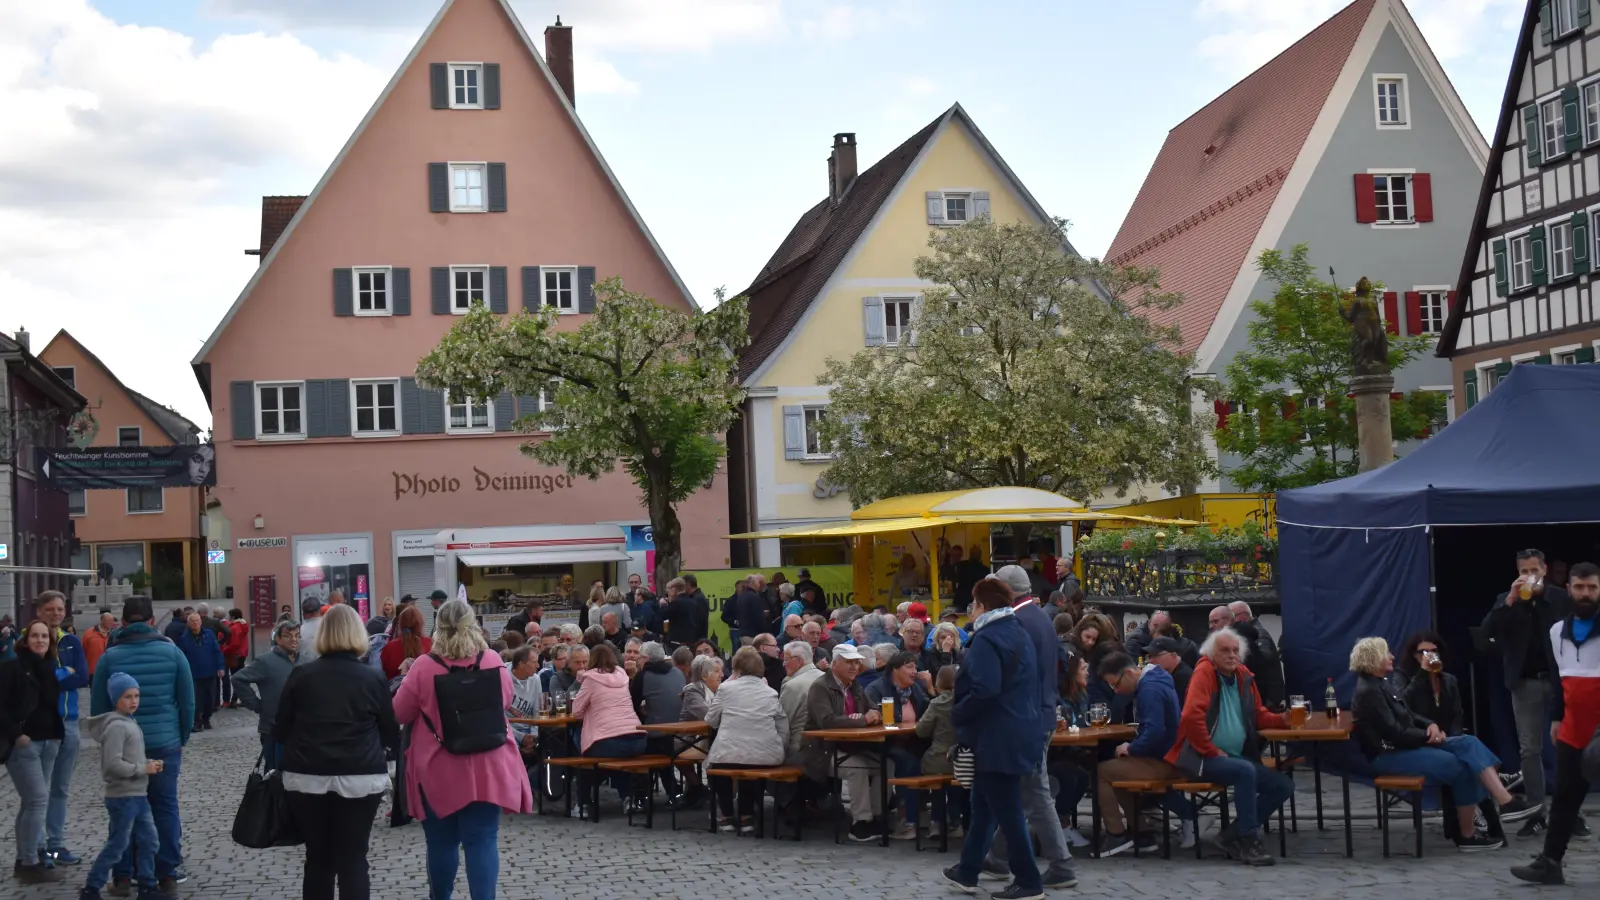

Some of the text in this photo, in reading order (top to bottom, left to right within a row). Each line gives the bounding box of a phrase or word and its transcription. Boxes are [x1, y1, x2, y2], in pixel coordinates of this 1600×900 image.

[55, 452, 102, 460] Feuchtwanger
[392, 465, 576, 501] Photo Deininger
[246, 537, 287, 548] museum
